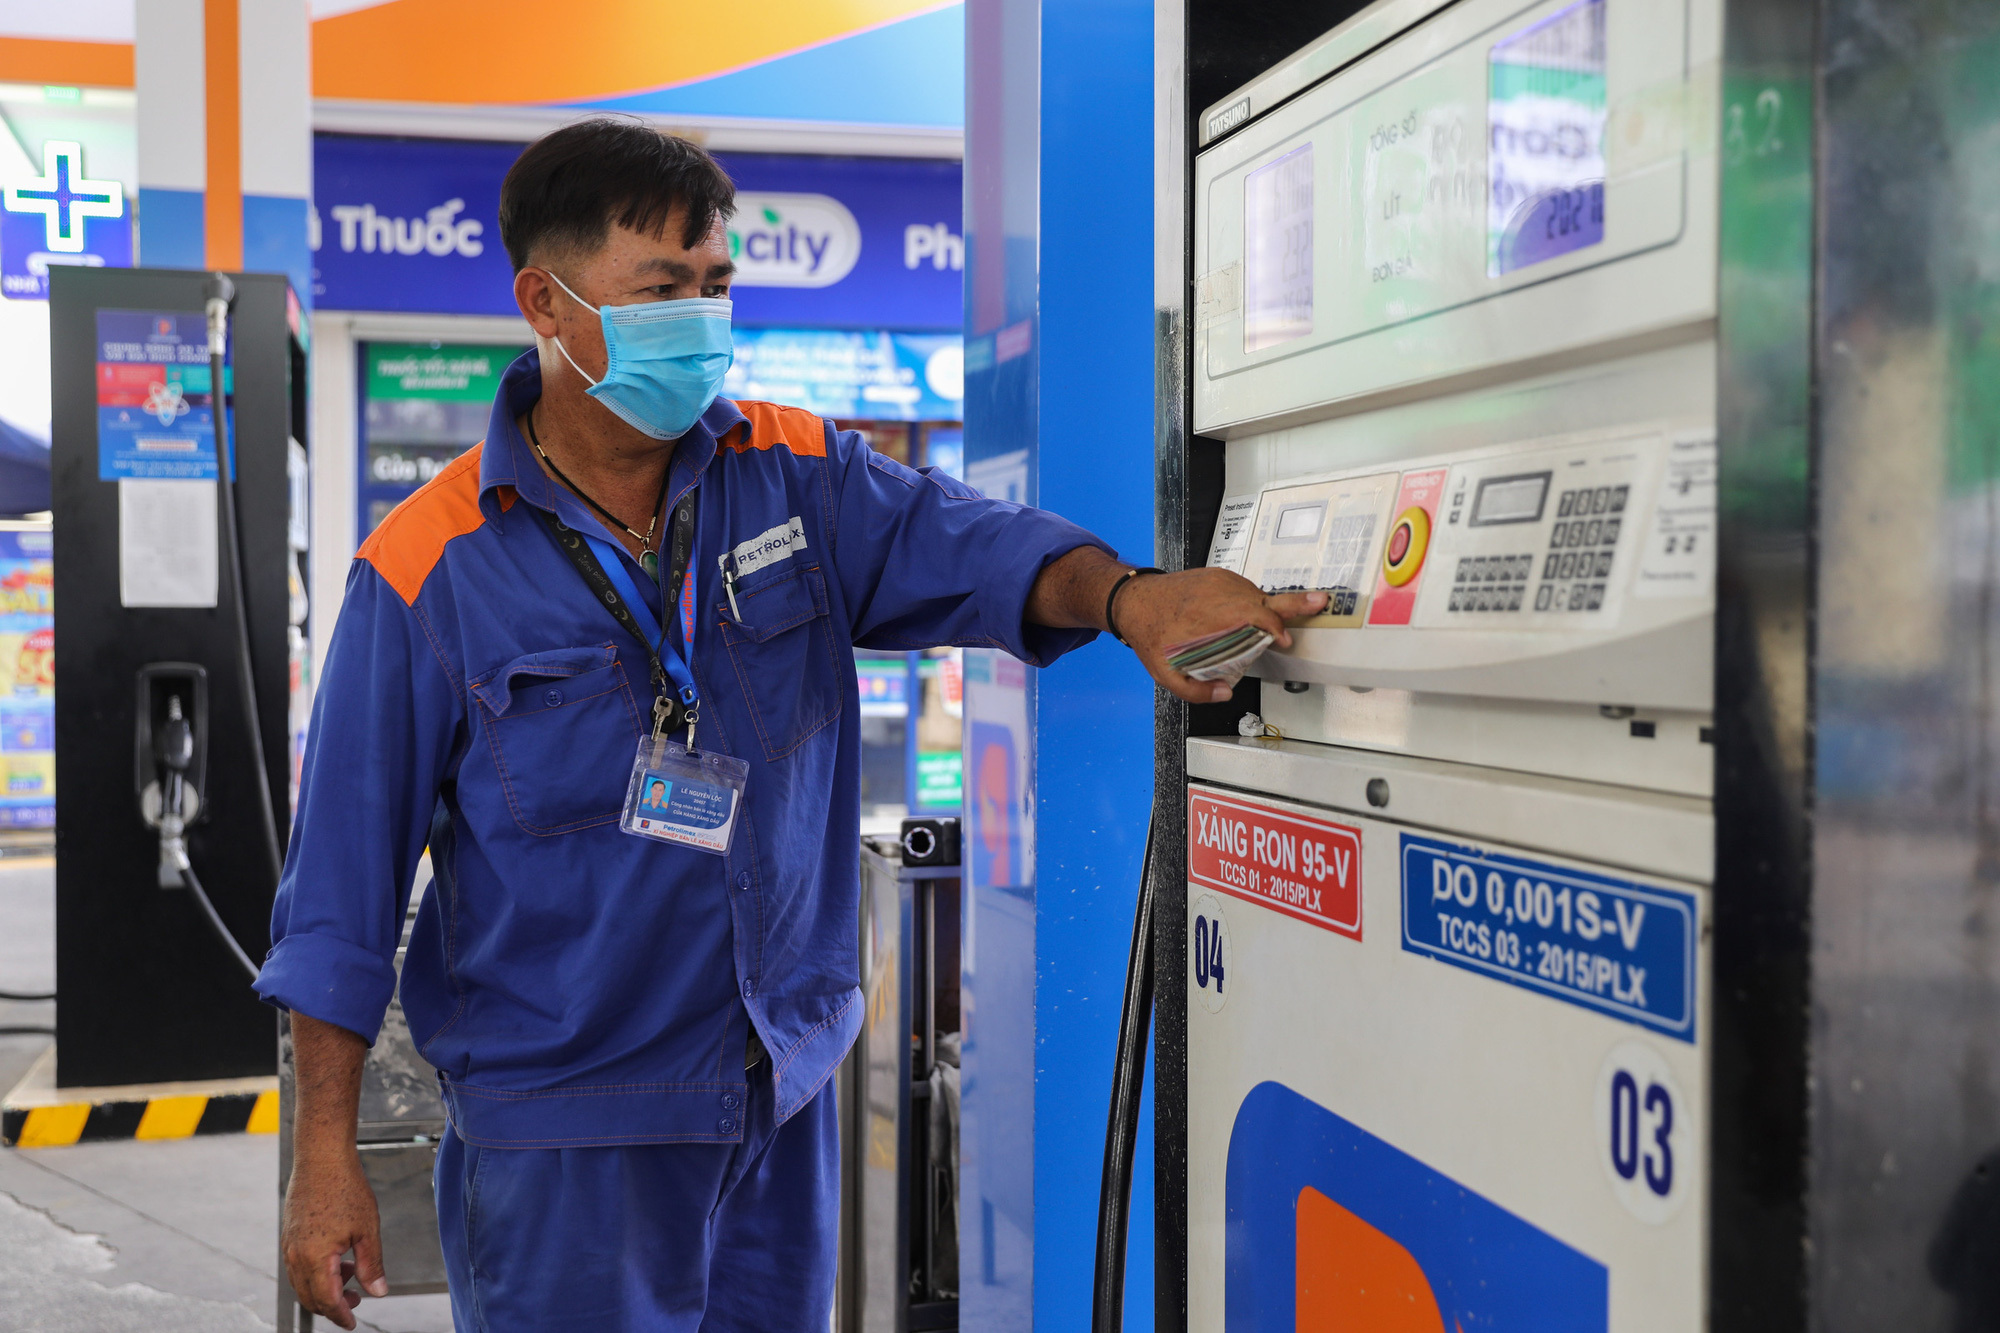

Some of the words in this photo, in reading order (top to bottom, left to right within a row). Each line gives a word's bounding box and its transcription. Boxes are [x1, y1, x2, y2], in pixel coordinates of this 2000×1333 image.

[1210, 101, 1247, 136] TATSUNO
[331, 197, 484, 258] Thuốc
[682, 571, 693, 643] Petrolimex
[663, 824, 696, 837] Petrolimex
[1197, 805, 1249, 859] XĂNG
[1253, 828, 1297, 875] RON
[1302, 842, 1351, 888] 95-V
[1219, 859, 1246, 886] TCCS
[1249, 870, 1261, 891] 01
[1270, 876, 1322, 913] 2015/PLX
[1432, 858, 1478, 907] DO
[1486, 872, 1646, 950] 0,001S-V
[1194, 914, 1224, 993] 04
[1437, 912, 1490, 958] TCCS
[1496, 931, 1521, 969] 03
[1538, 944, 1647, 1007] 2015/PLX
[1611, 1069, 1674, 1197] 03
